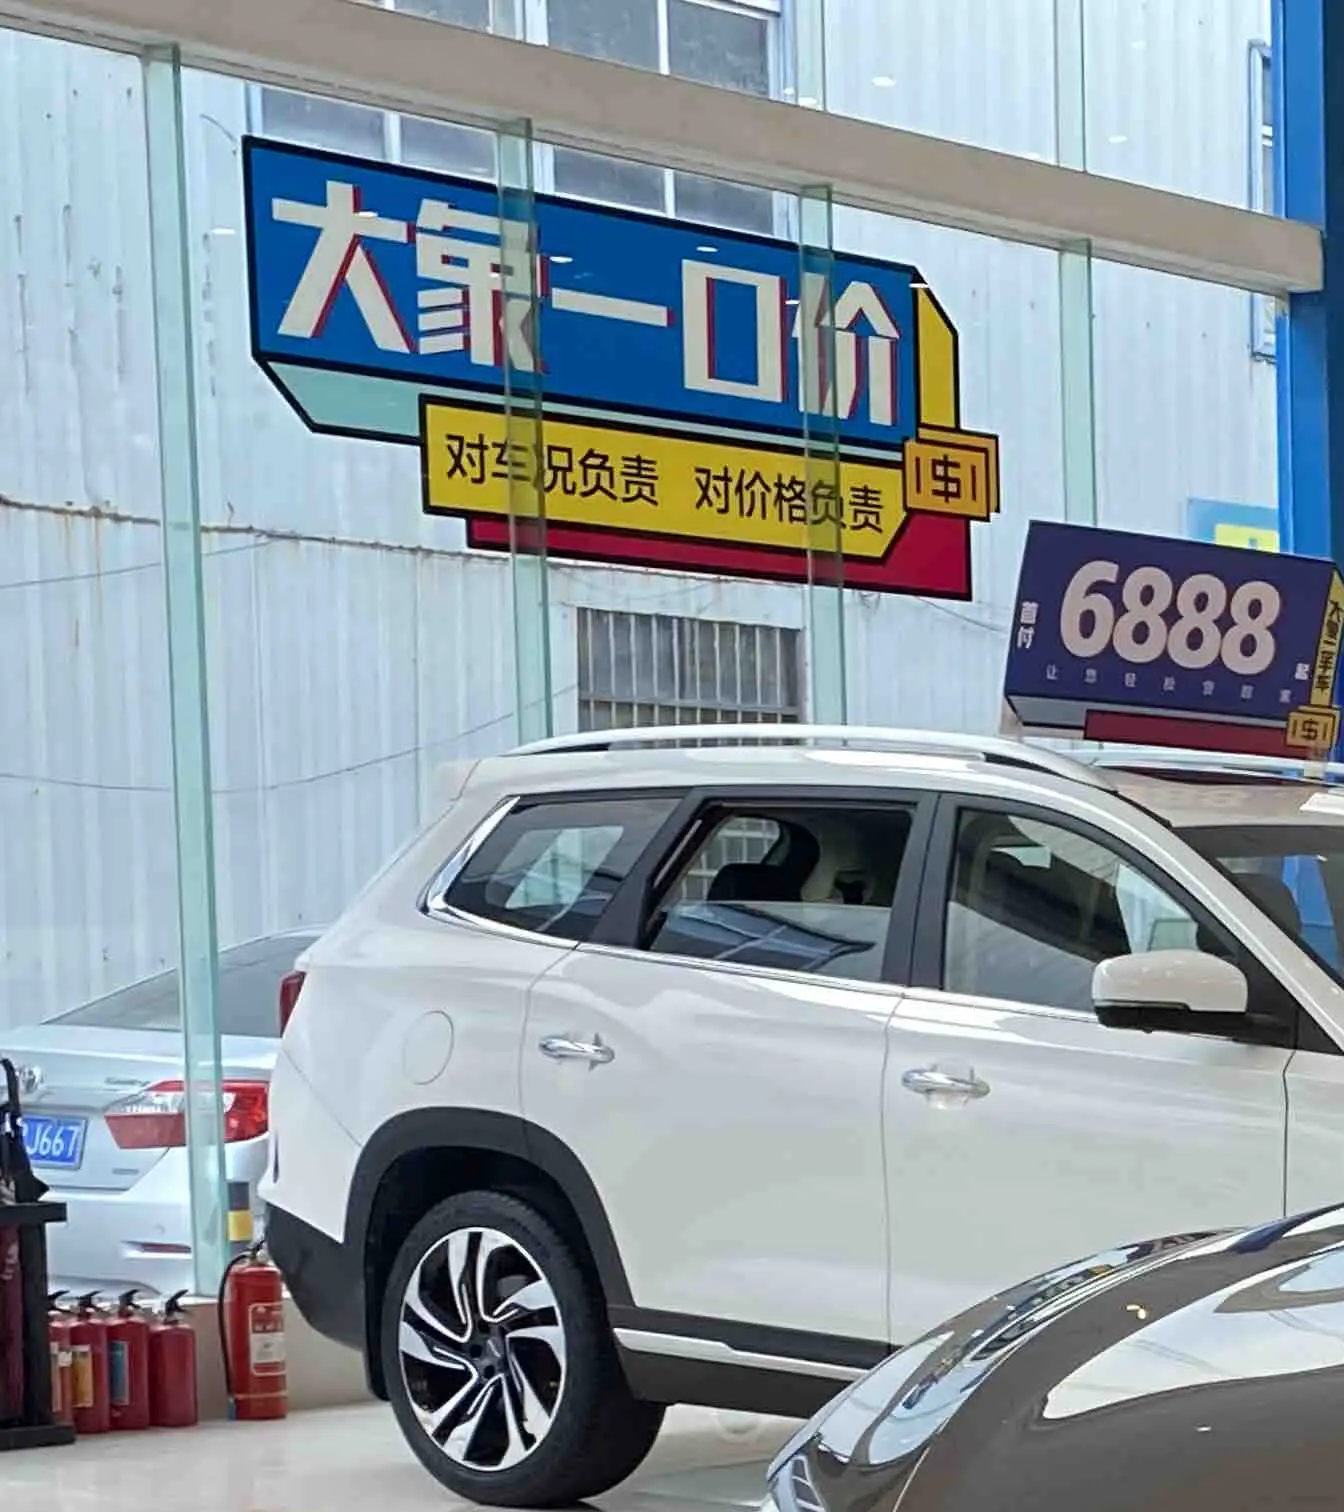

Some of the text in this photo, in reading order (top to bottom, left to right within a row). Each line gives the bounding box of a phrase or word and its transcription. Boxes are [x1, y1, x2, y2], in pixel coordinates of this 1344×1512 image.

[271, 180, 900, 426] 大象一口价
[445, 431, 885, 534] 对车况负责 对价格负责
[1016, 601, 1040, 649] 首付
[1060, 560, 1281, 675] 6888
[22, 1120, 79, 1159] J667
